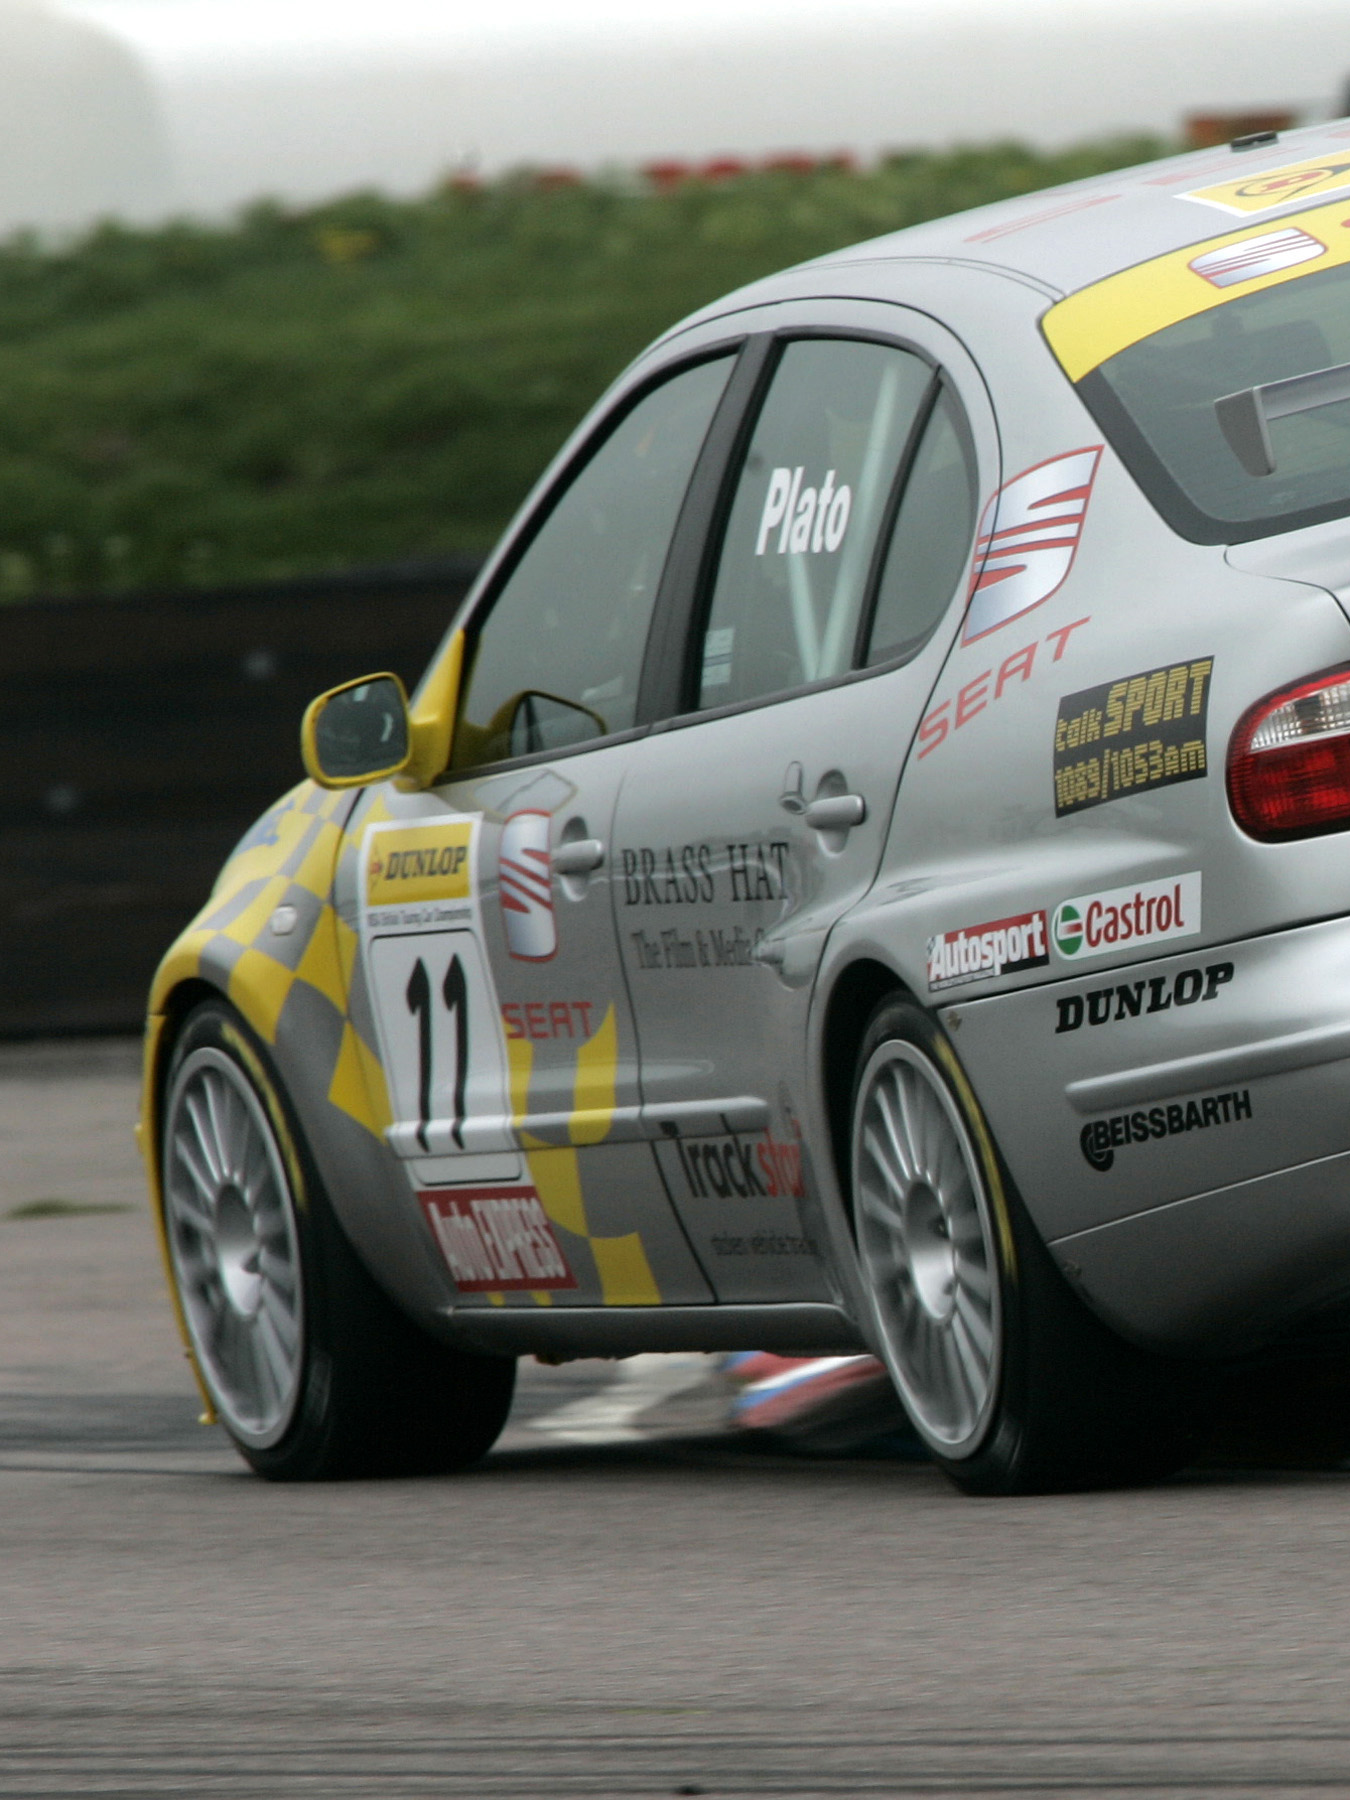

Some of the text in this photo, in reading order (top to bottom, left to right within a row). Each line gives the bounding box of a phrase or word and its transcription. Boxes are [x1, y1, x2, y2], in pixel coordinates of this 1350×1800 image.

[755, 465, 852, 556] Plato
[916, 616, 1092, 761] SEAT
[1055, 660, 1212, 752] talk SPORT
[384, 844, 468, 882] DUNLOP
[621, 841, 790, 906] BRASS HAT
[927, 883, 1186, 982] Autosport Castrol
[502, 1001, 595, 1040] SEAT
[1055, 961, 1236, 1034] DUNLOP
[405, 952, 470, 1153] 11
[1093, 1089, 1253, 1151] BEISSBARTH
